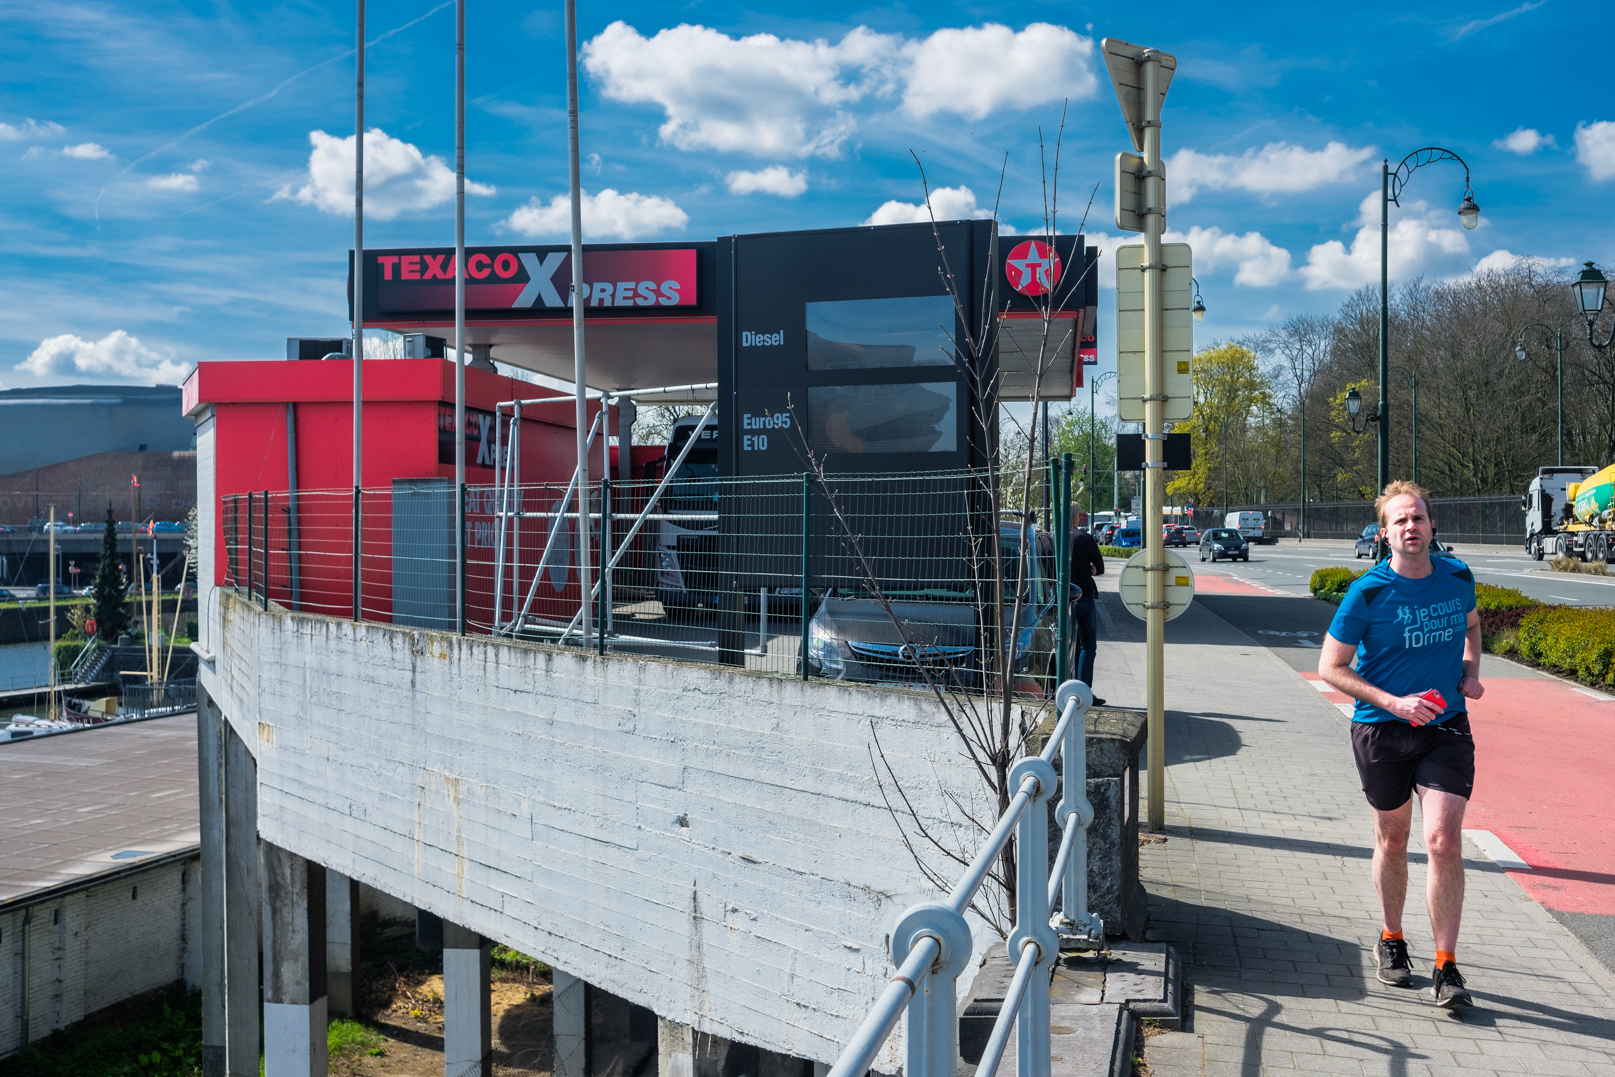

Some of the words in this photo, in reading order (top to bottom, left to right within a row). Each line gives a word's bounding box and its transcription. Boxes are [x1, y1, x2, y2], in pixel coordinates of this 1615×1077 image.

[377, 252, 519, 280] TEXACO
[742, 330, 784, 347] Diesel
[743, 412, 791, 429] Euro95
[743, 434, 768, 451] E10
[1414, 605, 1430, 626] je
[1430, 597, 1462, 617] cours
[1423, 616, 1449, 634] pour
[1450, 612, 1465, 626] ma
[1403, 625, 1454, 649] forme
